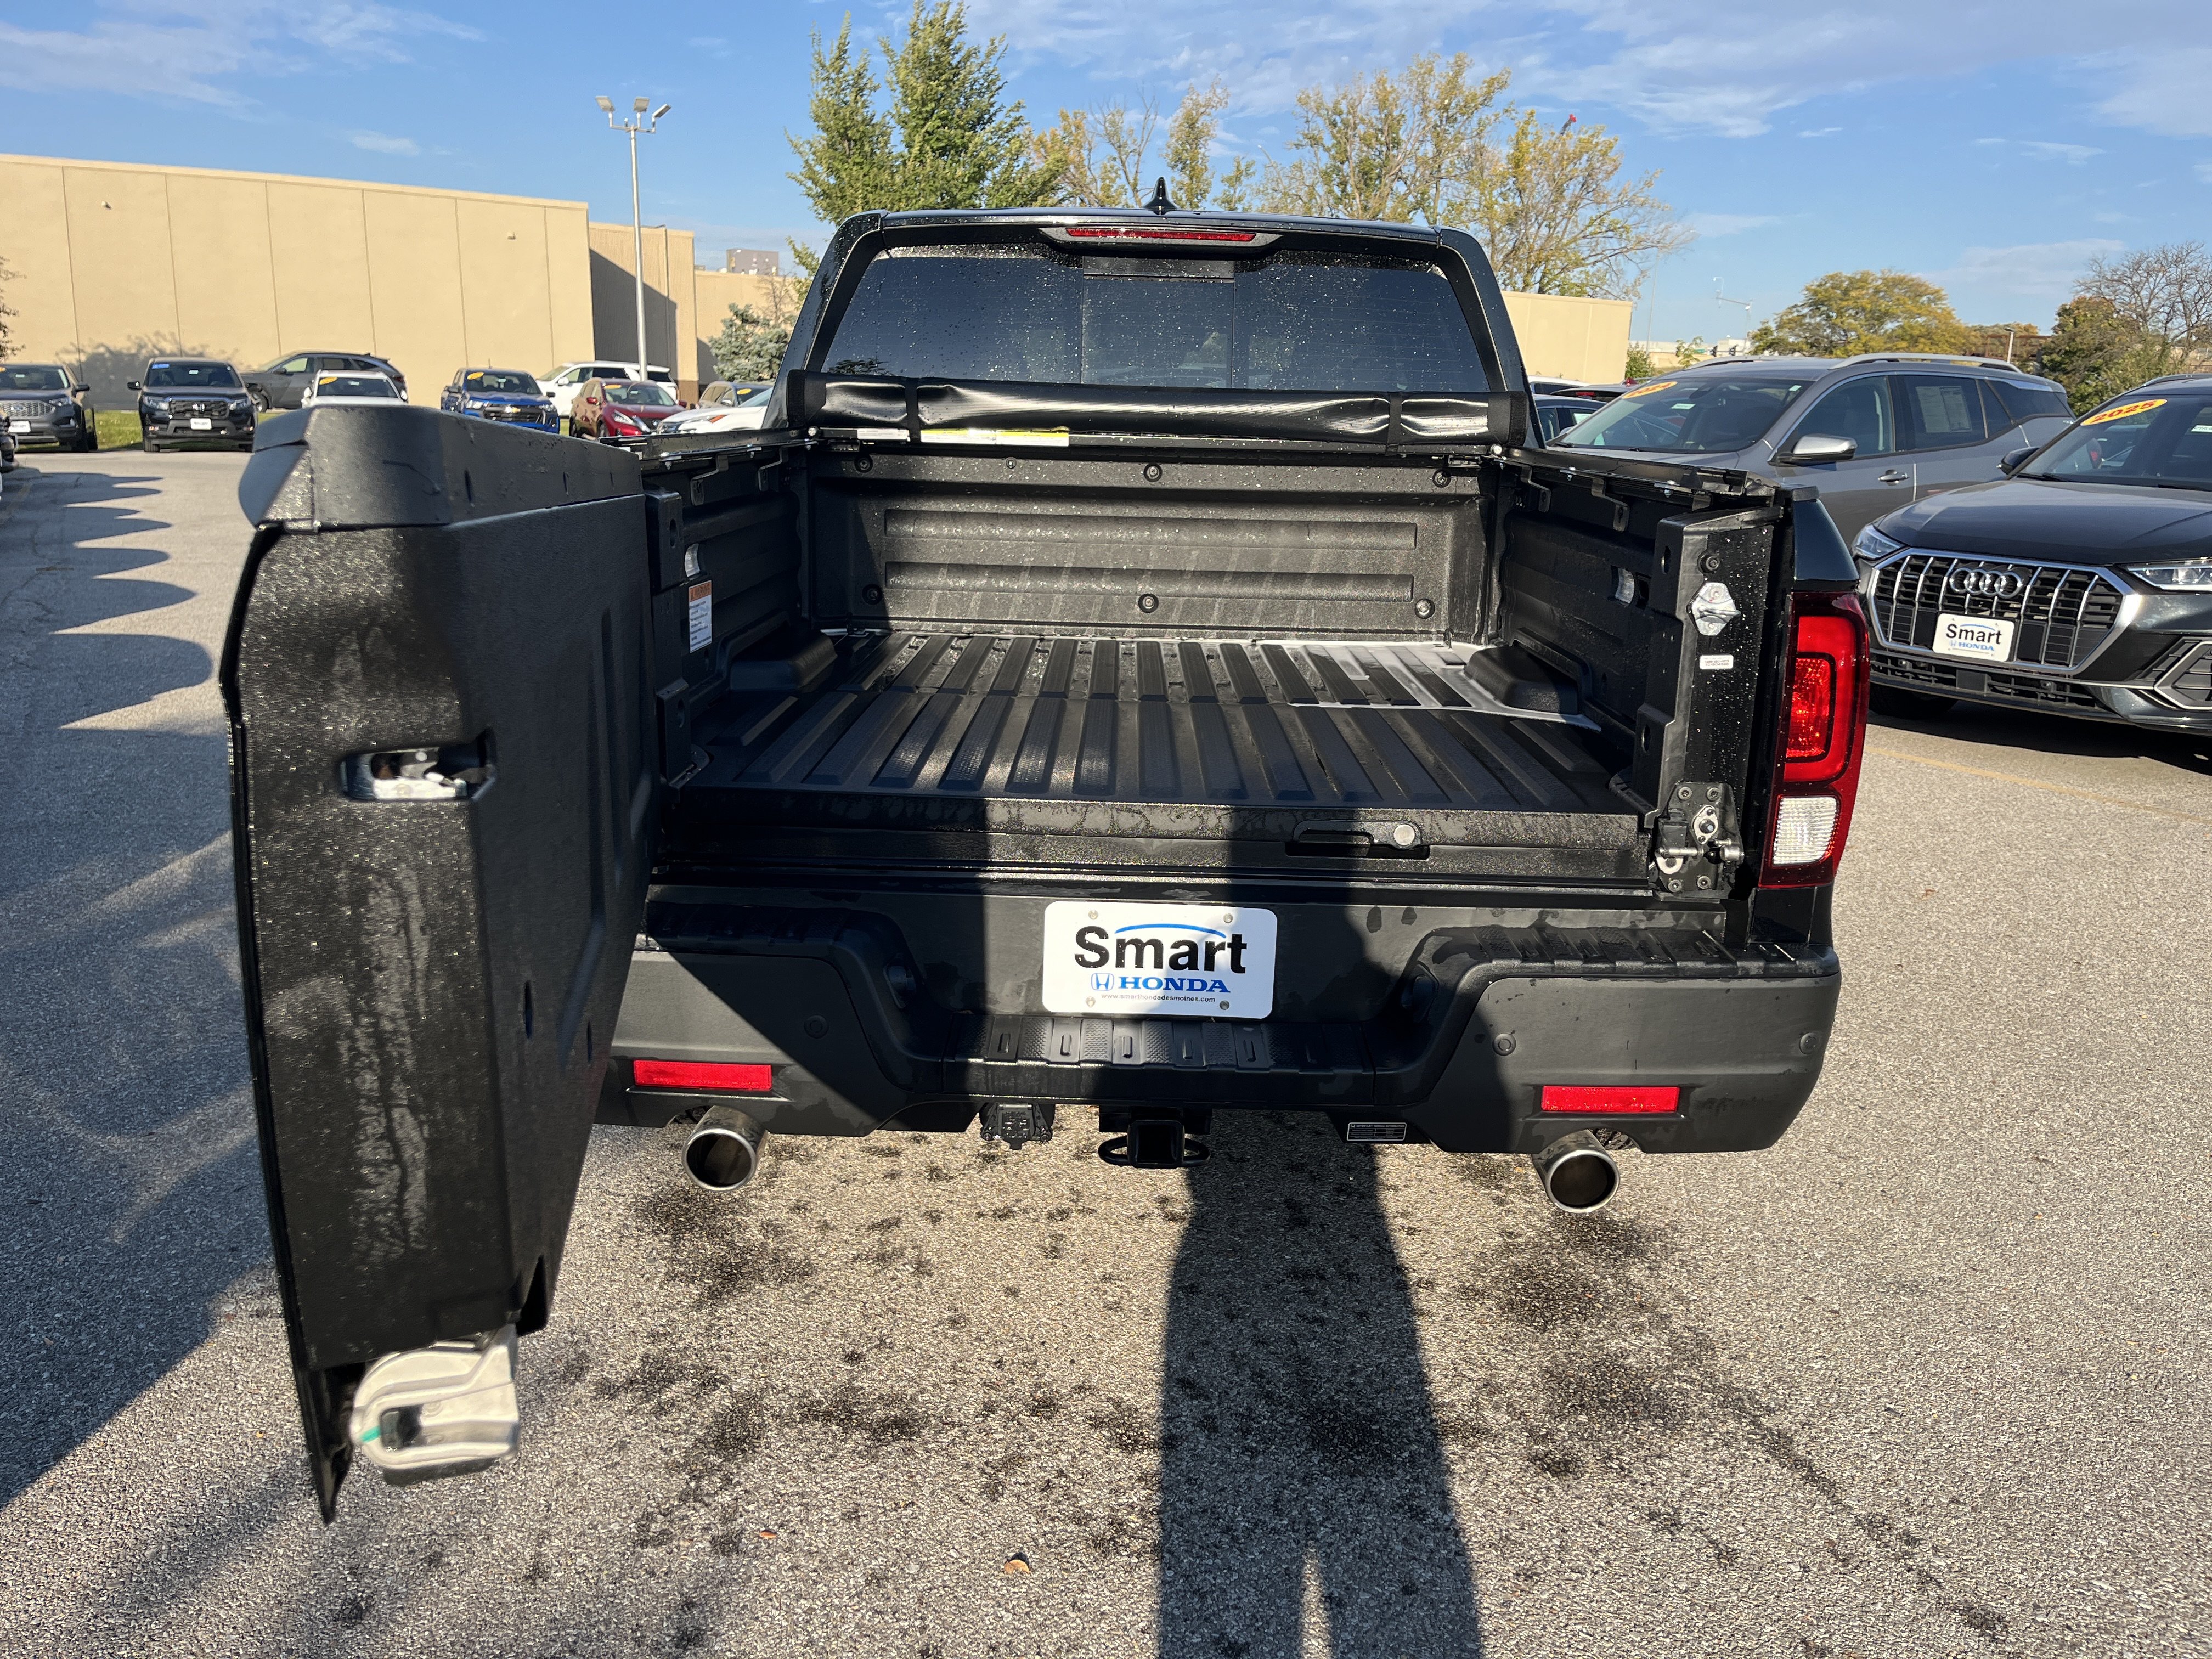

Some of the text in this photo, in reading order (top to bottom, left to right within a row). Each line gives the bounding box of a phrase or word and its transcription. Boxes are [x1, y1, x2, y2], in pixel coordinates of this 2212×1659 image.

[2090, 400, 2157, 424] 2025
[1946, 623, 2002, 644] Smart
[1958, 641, 1994, 651] HONDA
[1074, 926, 1248, 974] Smart
[1118, 977, 1231, 993] HONDA
[1101, 994, 1216, 1003] www.smarthondadesmoines.com
